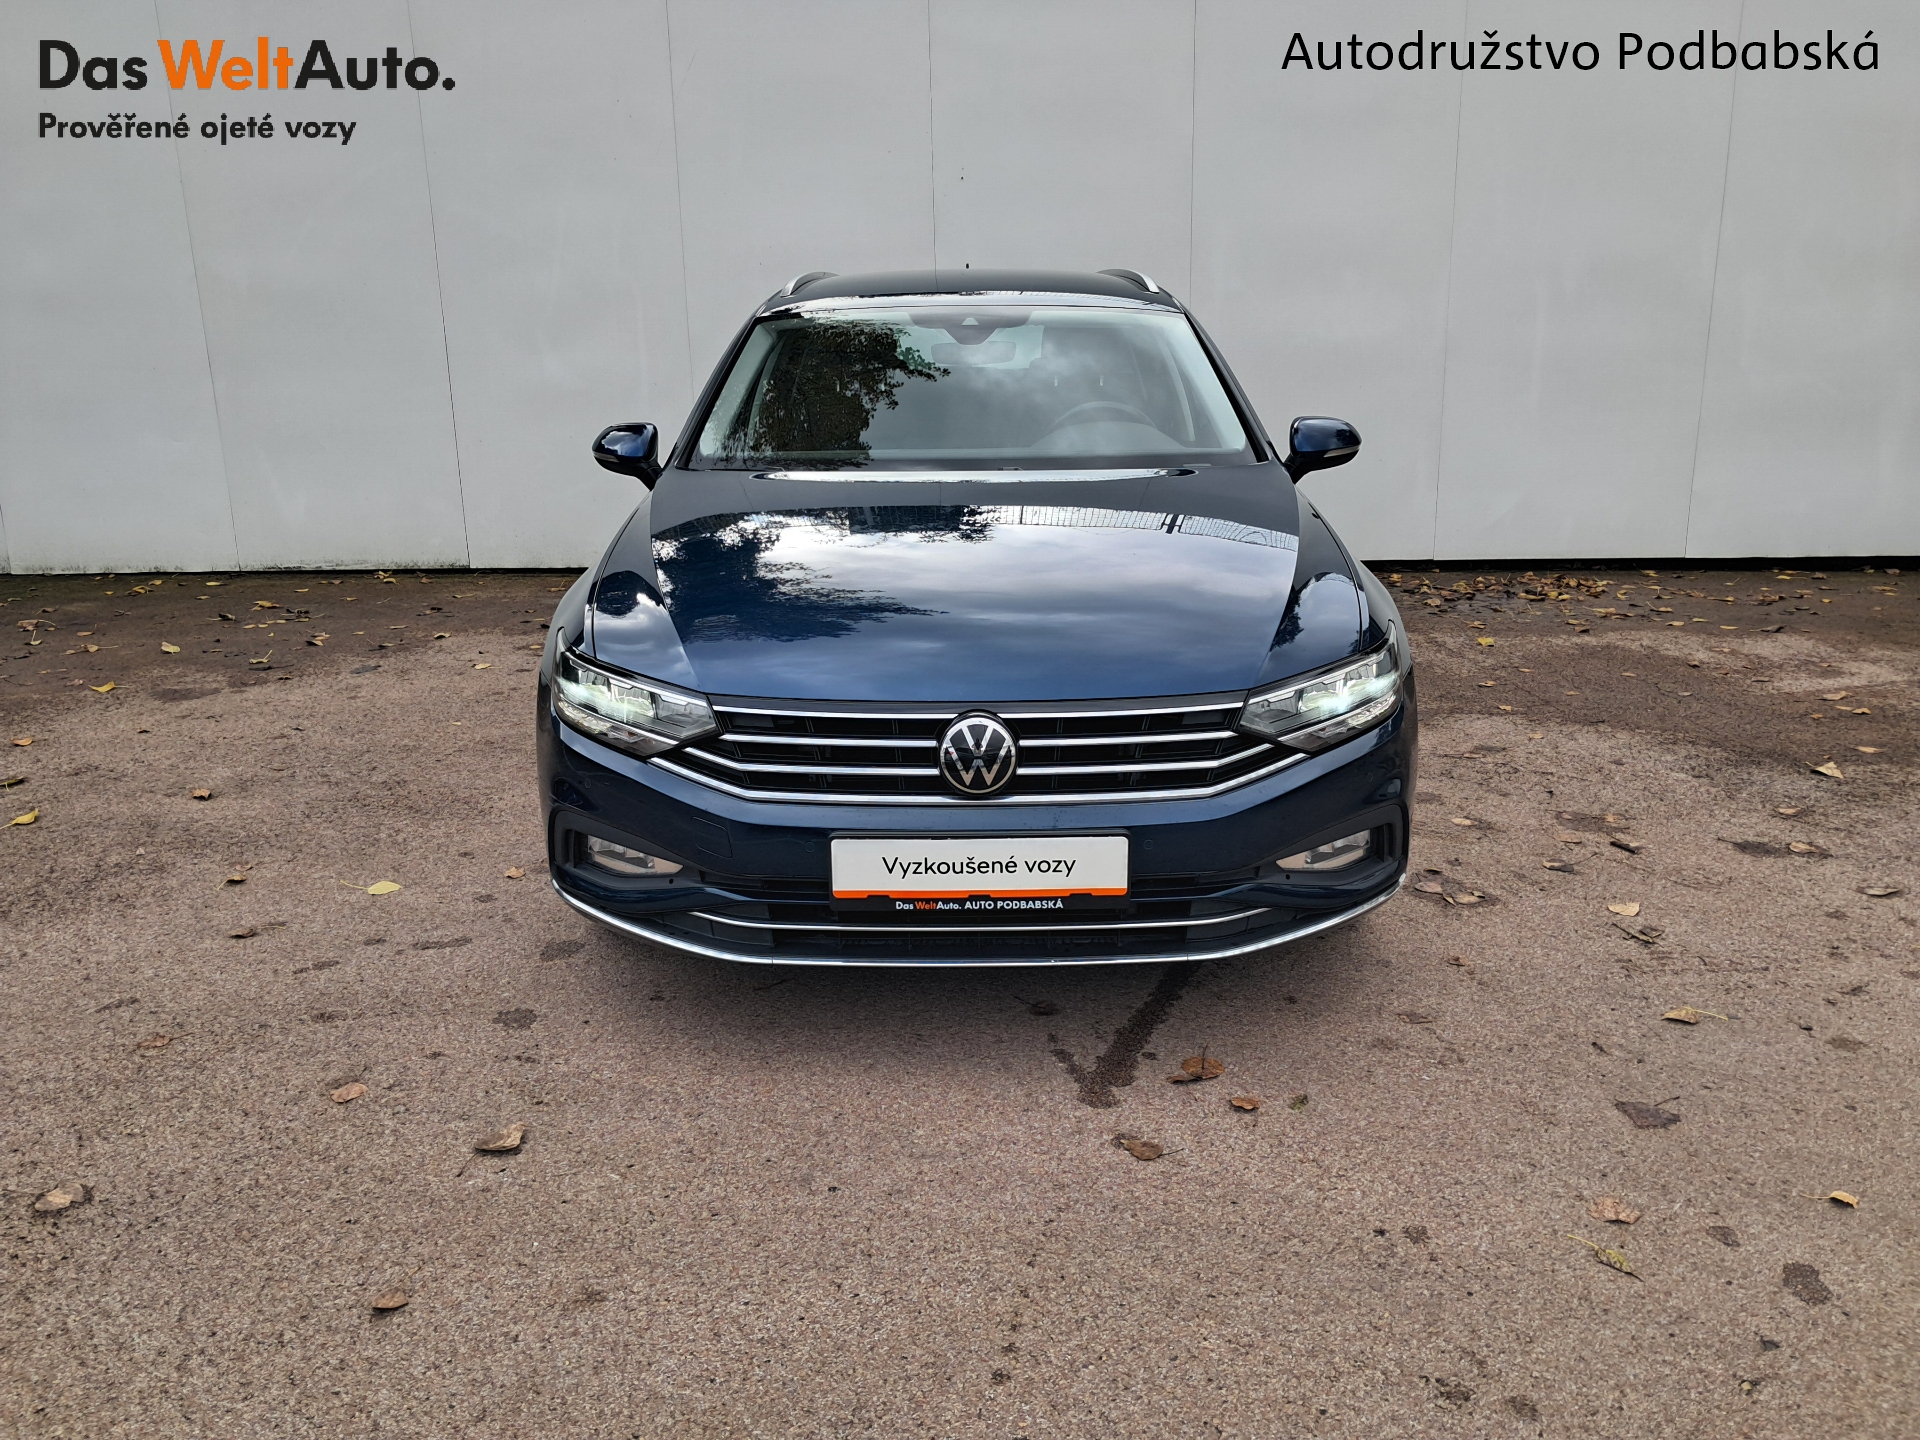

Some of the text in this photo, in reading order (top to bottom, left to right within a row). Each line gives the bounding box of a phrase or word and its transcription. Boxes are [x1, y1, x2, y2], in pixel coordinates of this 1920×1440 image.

[881, 855, 1076, 879] Vyzkoušené vozy
[895, 901, 914, 910] Das
[964, 900, 996, 910] AUTO
[996, 898, 1064, 910] PODBABSKÁ
